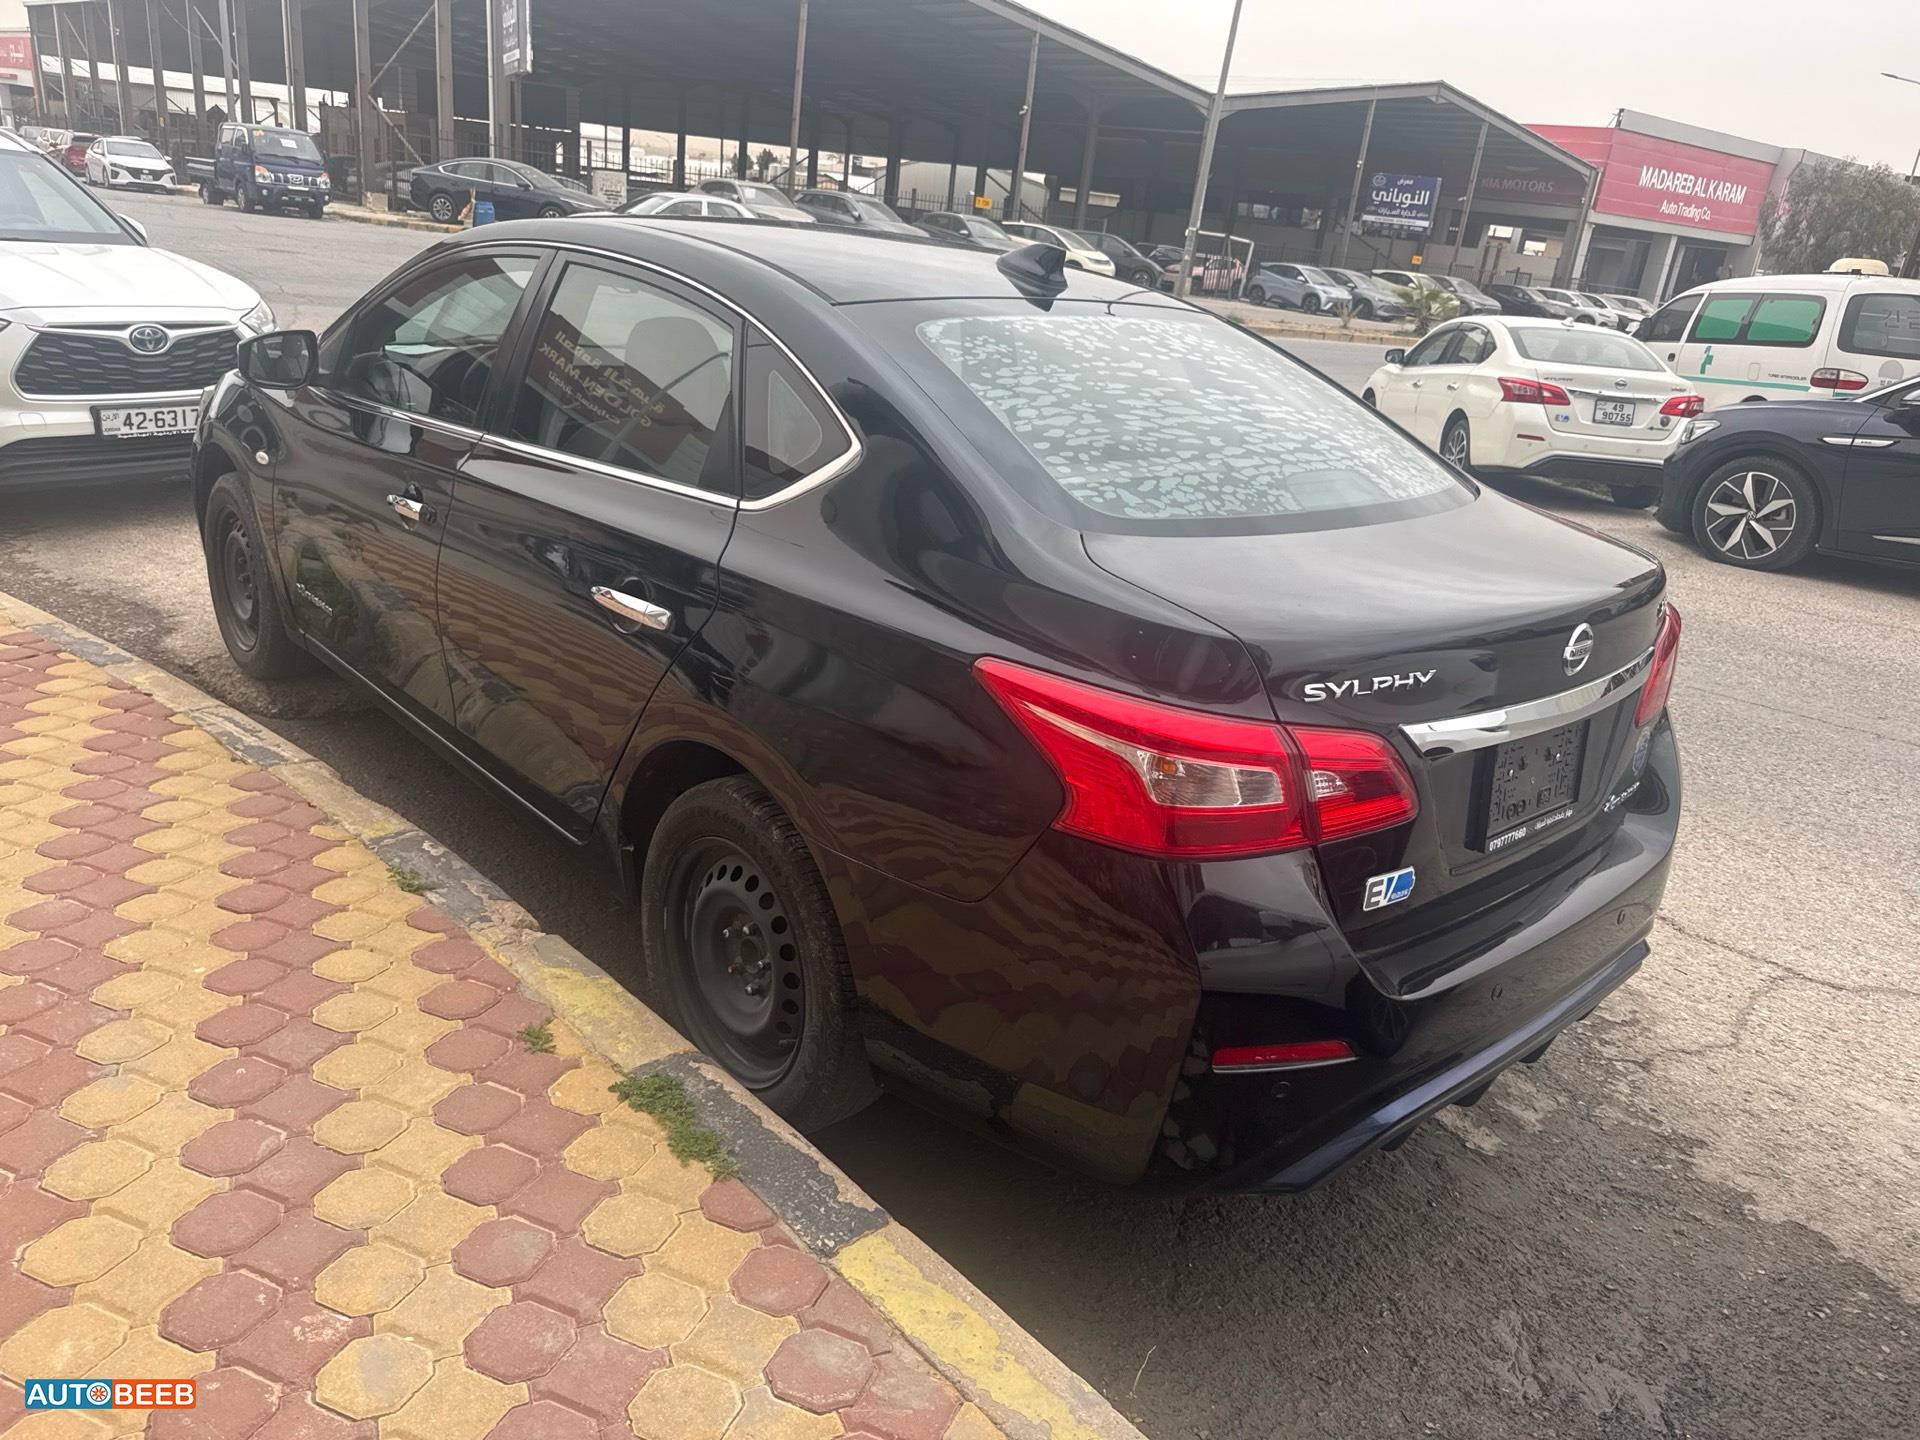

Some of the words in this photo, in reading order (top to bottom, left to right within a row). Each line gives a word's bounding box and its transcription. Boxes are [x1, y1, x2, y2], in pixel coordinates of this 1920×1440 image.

[1502, 179, 1554, 193] MOTORS
[1639, 164, 1695, 195] MADAREB
[1692, 176, 1707, 198] AL
[1706, 179, 1748, 206] KARAM
[1372, 187, 1430, 208] النوباني
[1660, 199, 1678, 215] Auto
[1677, 202, 1702, 222] Trading
[1303, 669, 1437, 703] SYLPHY
